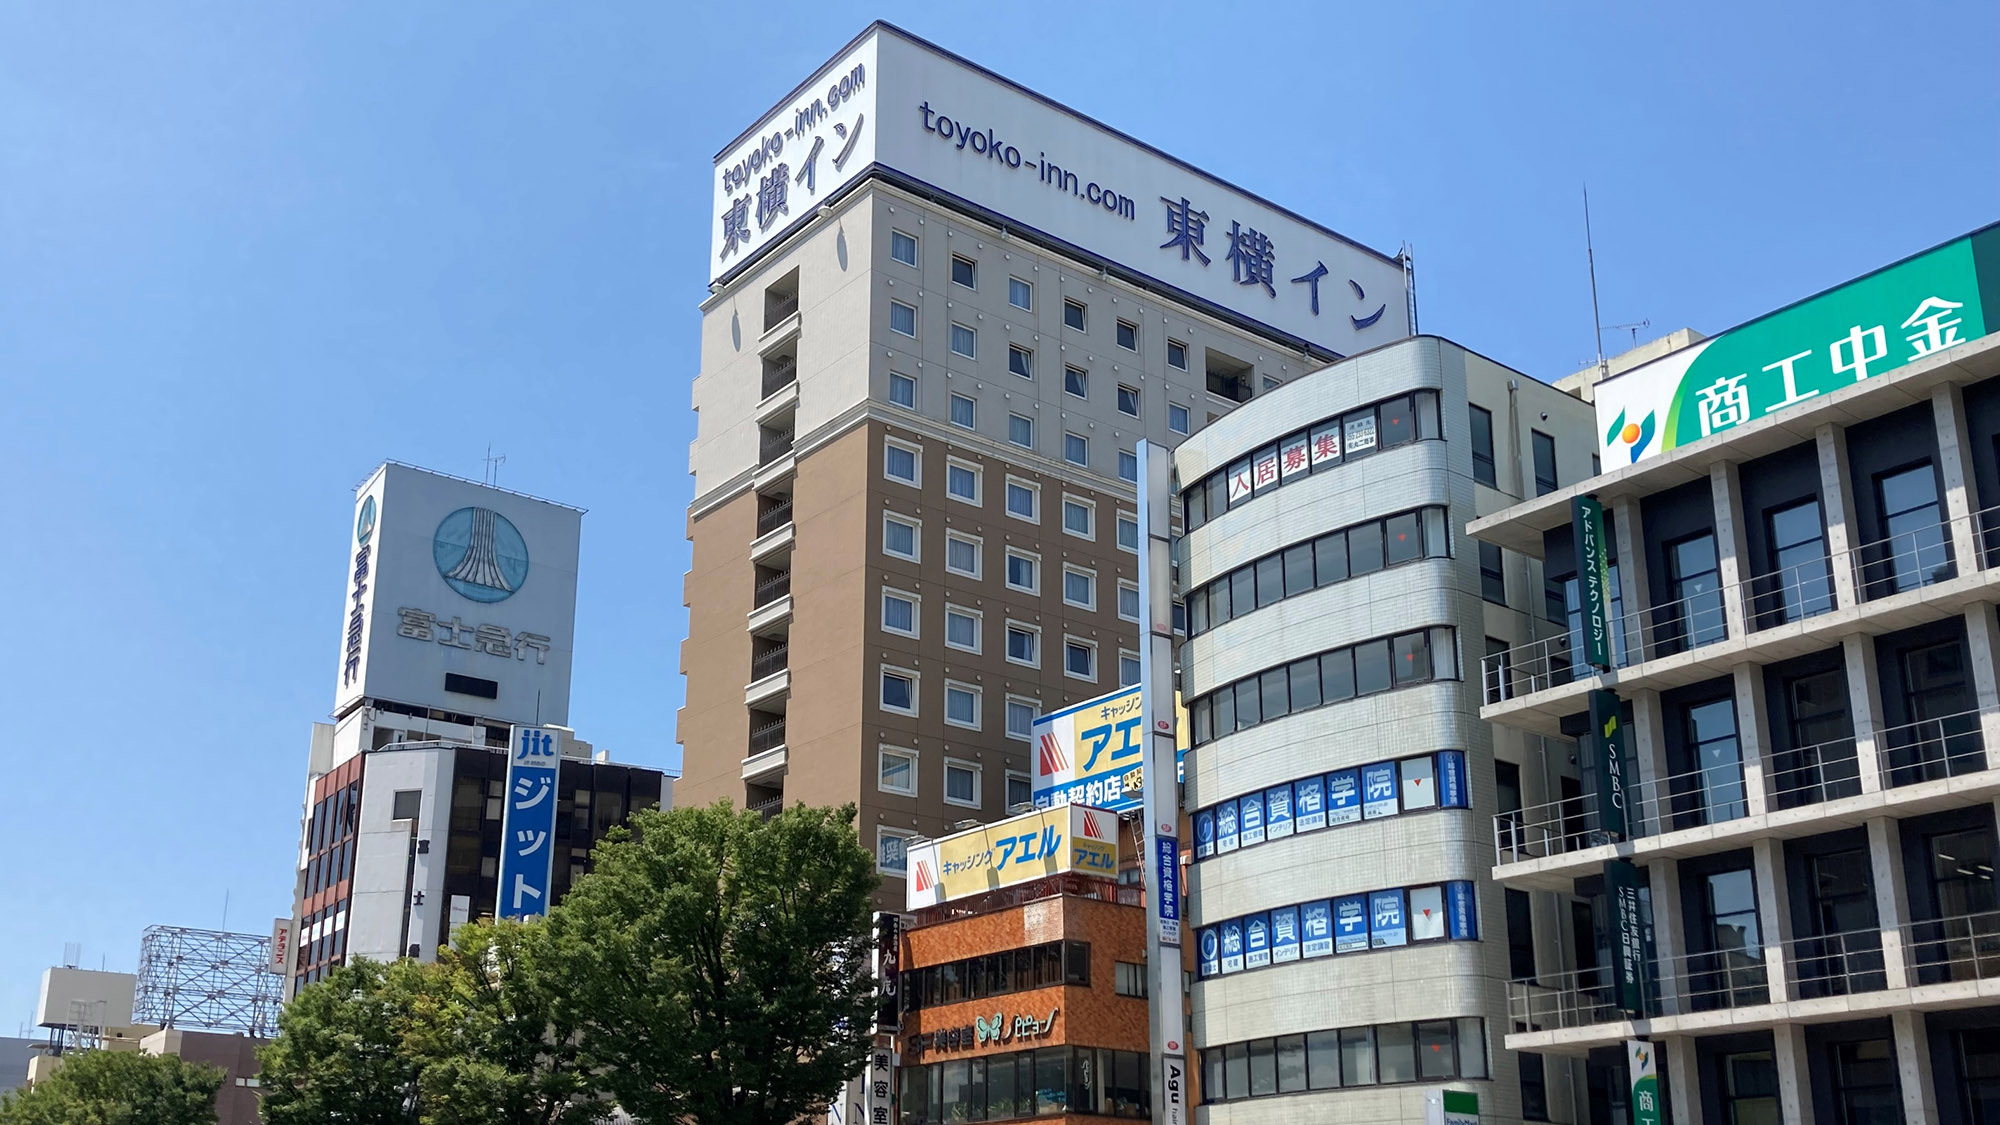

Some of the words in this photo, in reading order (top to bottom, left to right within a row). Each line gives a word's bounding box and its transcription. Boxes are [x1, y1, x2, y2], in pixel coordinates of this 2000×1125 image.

[722, 61, 866, 193] toyoko-inn.com
[918, 101, 1136, 222] toyoko-inn.com
[719, 112, 865, 259] 東横イン
[1159, 195, 1387, 332] 東横イン
[1695, 296, 1966, 438] 商工中金
[1231, 432, 1338, 499] 入居募集
[1581, 506, 1603, 656] アドバンステクノロジー
[344, 544, 371, 689] 富士急行
[397, 606, 551, 665] 富士急行
[517, 729, 554, 760] jit
[1608, 743, 1622, 809] SMBC
[1217, 768, 1393, 837] 総合資格学院
[513, 776, 552, 909] ジット
[943, 848, 993, 877] キャッシング
[995, 825, 1061, 871] アエル
[1073, 848, 1115, 870] アエル
[1223, 896, 1400, 955] 総合資格学院
[1275, 946, 1298, 958] インテリア
[1626, 887, 1641, 962] 三井住友銀行
[873, 1054, 888, 1125] 美容室
[1168, 1064, 1181, 1105] Agu
